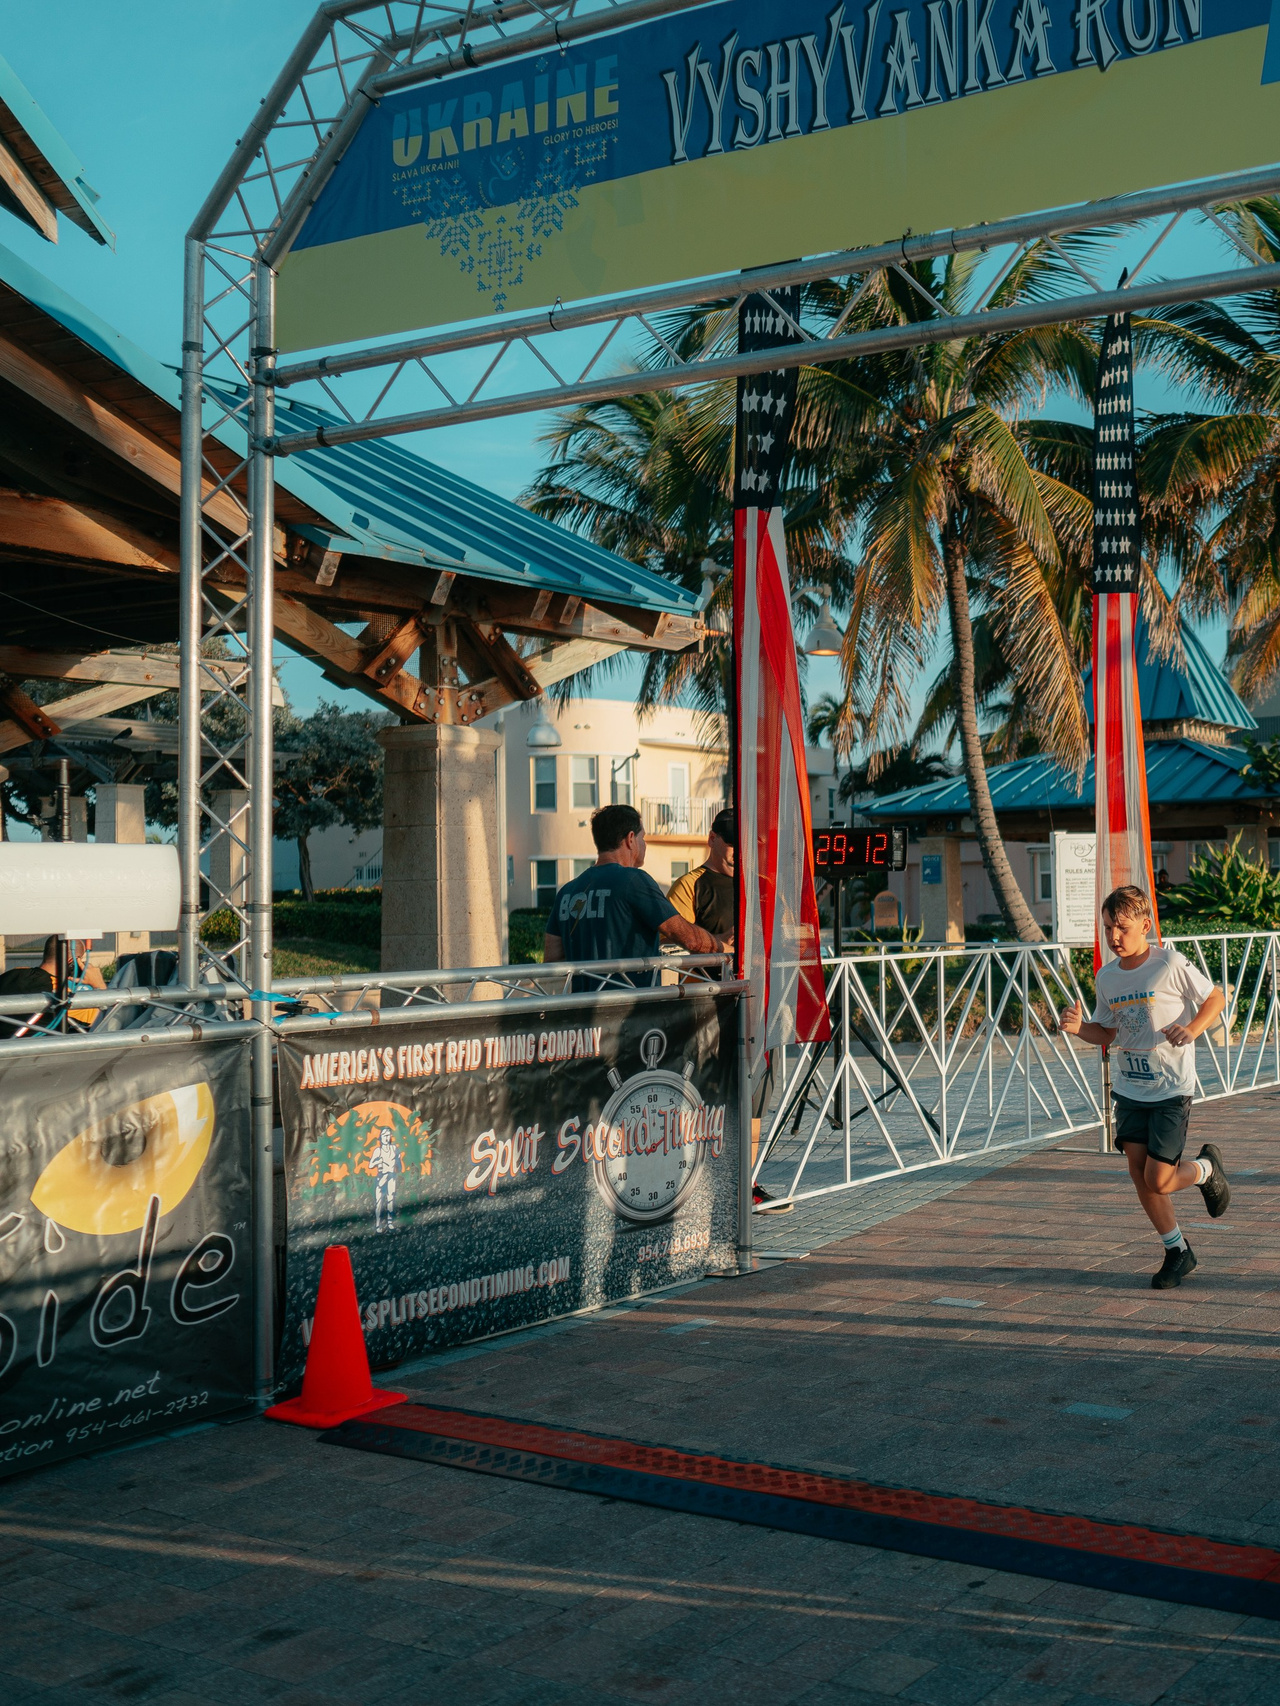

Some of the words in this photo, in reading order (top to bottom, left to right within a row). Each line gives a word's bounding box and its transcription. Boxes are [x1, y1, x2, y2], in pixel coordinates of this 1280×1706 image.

[662, 0, 1057, 165] VYSHYVANKA
[1073, 0, 1204, 73] RUN
[392, 54, 619, 167] UKRAINE
[543, 132, 571, 146] GLORY
[572, 128, 583, 139] TO
[585, 118, 619, 135] HEROES!
[392, 168, 419, 182] SLAVA
[420, 159, 460, 175] UKRAINI!
[559, 889, 611, 921] BOLT
[300, 1047, 395, 1089] AMERICA'S
[398, 1042, 444, 1079] FIRST
[446, 1038, 482, 1074] RFID
[484, 1033, 536, 1069] TIMING
[538, 1027, 602, 1065] COMPANY
[1126, 1057, 1150, 1072] 116
[630, 1105, 641, 1114] 55
[648, 1094, 658, 1103] 60
[464, 1123, 546, 1197] Split
[552, 1104, 652, 1175] Second
[658, 1100, 726, 1160] Timing
[617, 1172, 628, 1181] 40
[678, 1160, 687, 1169] 20
[630, 1187, 641, 1196] 35
[648, 1191, 659, 1201] 30
[665, 1181, 676, 1190] 25
[637, 1230, 710, 1263] 954.749.6933
[0, 1193, 240, 1377] ide
[301, 1256, 570, 1348] .SPLITSECONDTIMING.COM
[0, 1439, 54, 1463] tion
[65, 1391, 209, 1444] 954-661-2732
